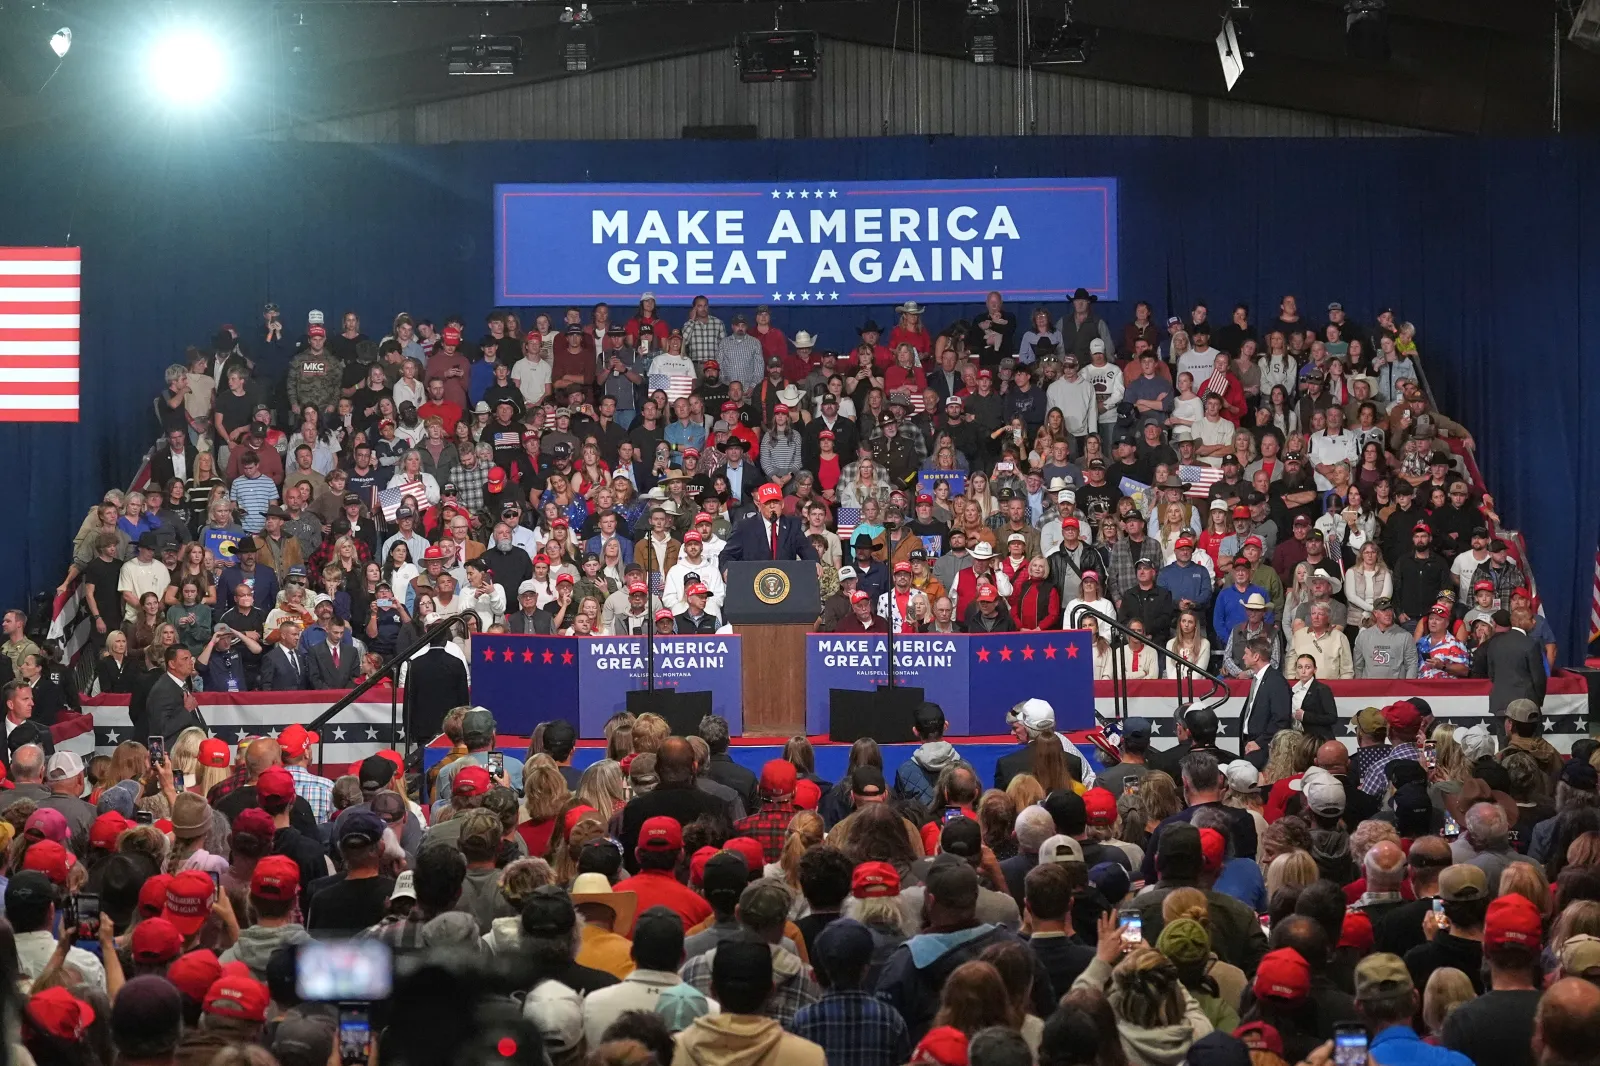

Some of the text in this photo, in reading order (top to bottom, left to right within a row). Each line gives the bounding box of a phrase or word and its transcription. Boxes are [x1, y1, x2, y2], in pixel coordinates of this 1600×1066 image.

[592, 205, 1021, 245] MAKE AMERICA
[607, 246, 1003, 285] GREAT AGAIN!
[303, 362, 325, 371] MKC
[761, 487, 778, 496] USA
[210, 534, 241, 542] MONTAN
[591, 643, 641, 655] MAKE
[818, 641, 868, 652] MAKE
[661, 657, 724, 668] AGAIN!
[824, 655, 882, 667] GREAT
[1373, 650, 1390, 664] 250
[220, 987, 243, 998] TRUMP
